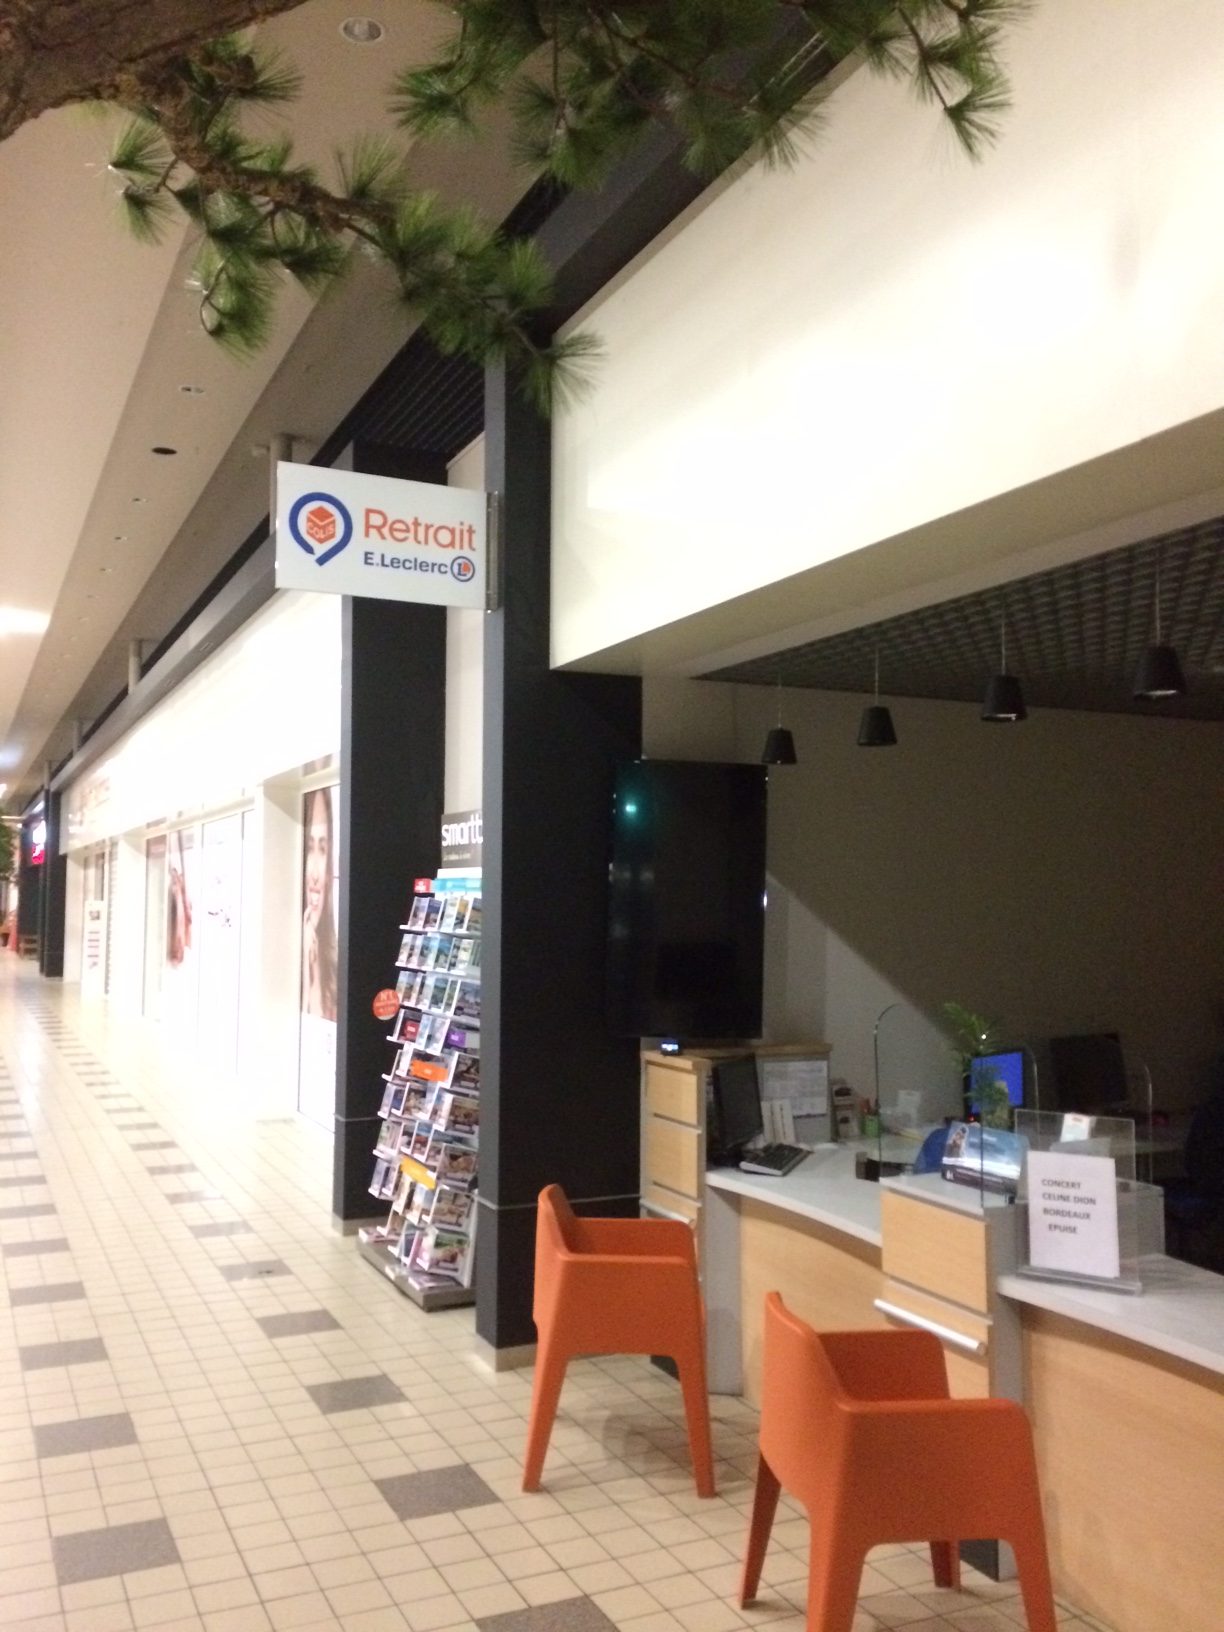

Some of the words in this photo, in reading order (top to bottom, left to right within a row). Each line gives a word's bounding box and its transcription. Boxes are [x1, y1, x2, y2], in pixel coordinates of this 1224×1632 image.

[363, 508, 476, 551] Retrait
[363, 551, 448, 575] E.Leclerc
[1041, 1179, 1081, 1190] CONCERT
[1042, 1192, 1070, 1202] CELINE
[1073, 1195, 1096, 1205] DION
[1043, 1207, 1091, 1219] BORDEAUX
